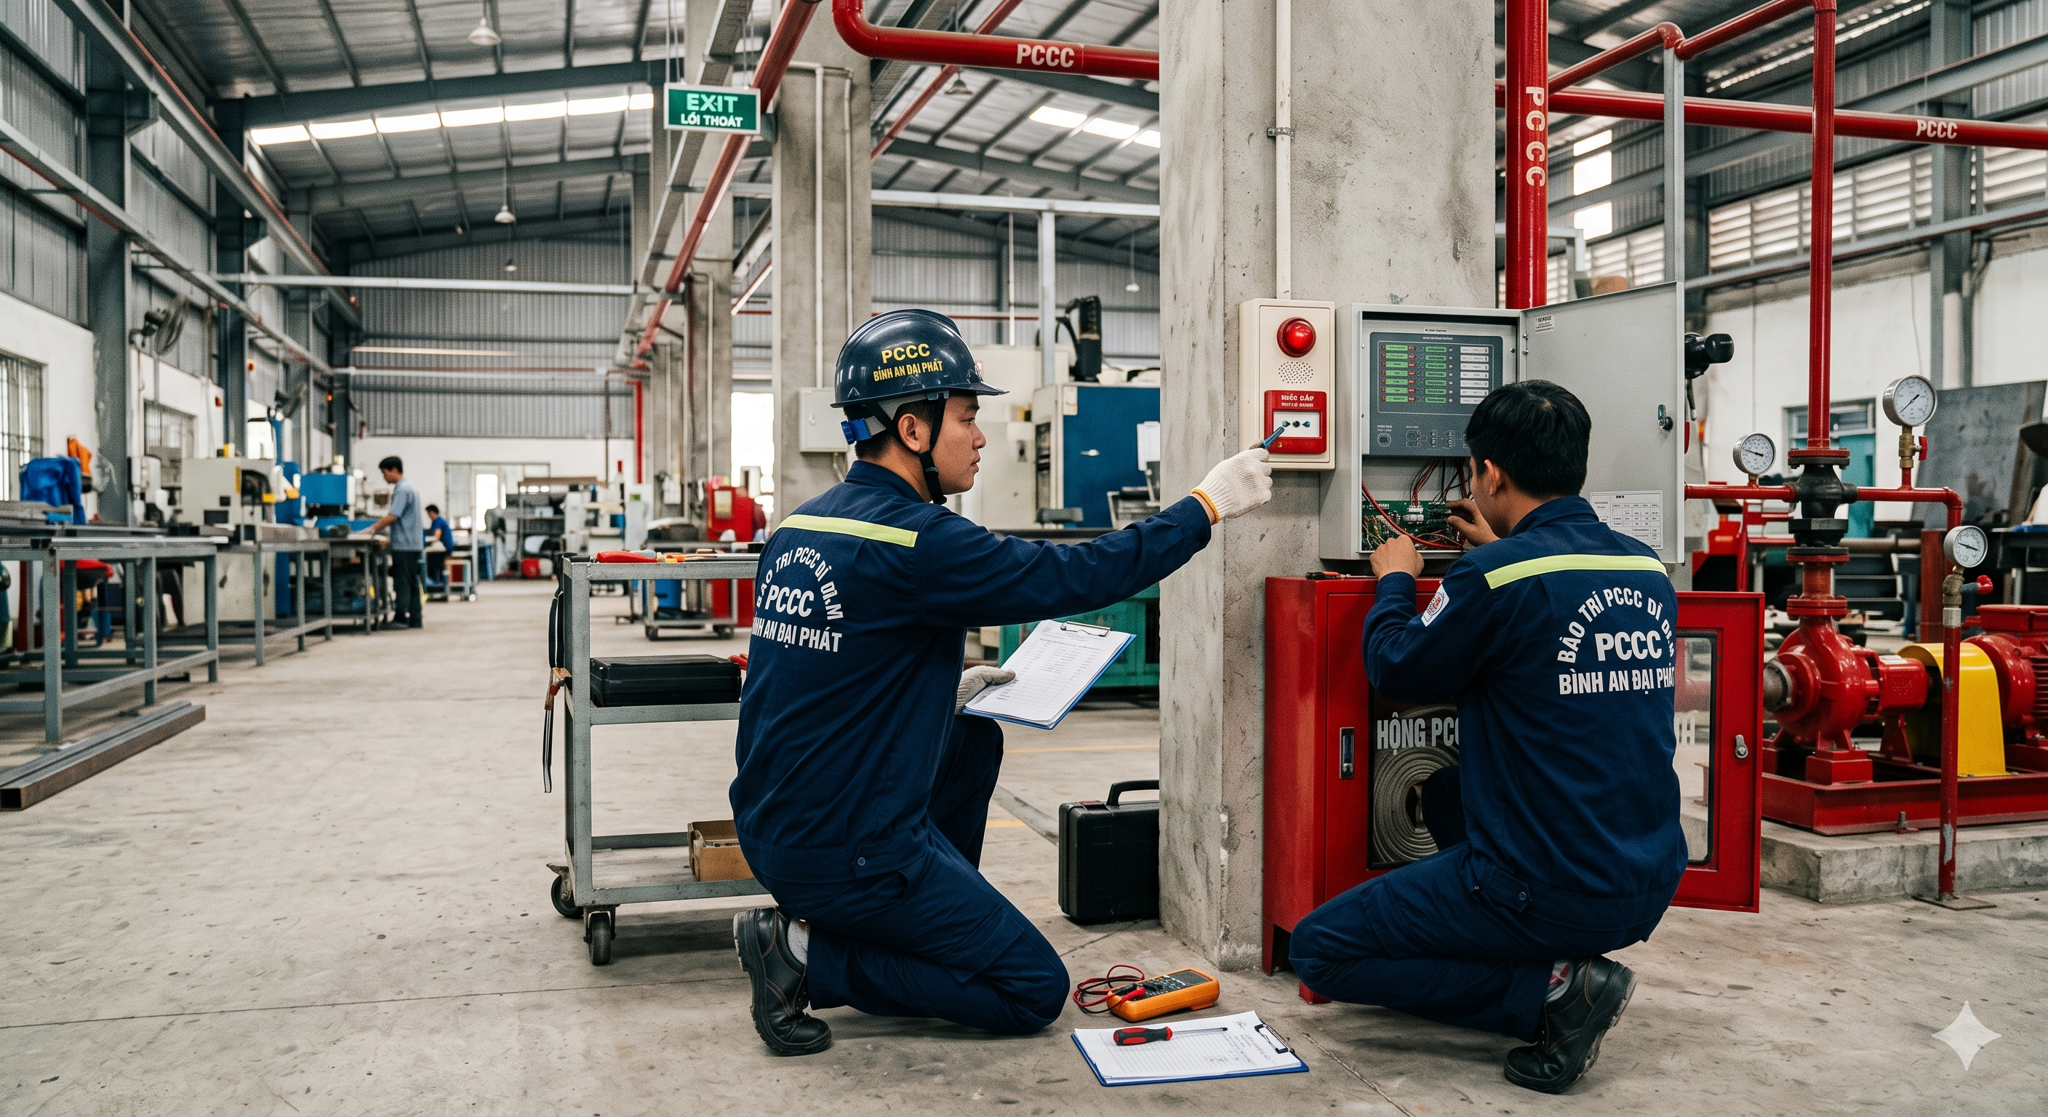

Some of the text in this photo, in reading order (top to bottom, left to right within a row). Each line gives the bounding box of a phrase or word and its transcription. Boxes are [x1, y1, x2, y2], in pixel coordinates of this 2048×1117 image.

[1016, 43, 1075, 68] PCCC
[686, 93, 738, 113] EXIT
[1525, 86, 1546, 187] PCCC
[1916, 119, 1958, 139] PCCC
[881, 343, 931, 364] PCCC
[894, 365, 906, 377] AN
[793, 547, 821, 569] PCCC
[765, 584, 815, 617] PCCC
[1603, 587, 1643, 608] PCCC
[763, 619, 778, 640] AN
[799, 626, 843, 652] PHÁT
[1594, 630, 1662, 662] PCCC
[1558, 668, 1604, 695] BÌNH
[1608, 669, 1630, 692] AN
[1632, 668, 1655, 695] ĐẠI
[1377, 711, 1426, 756] HỘNG
